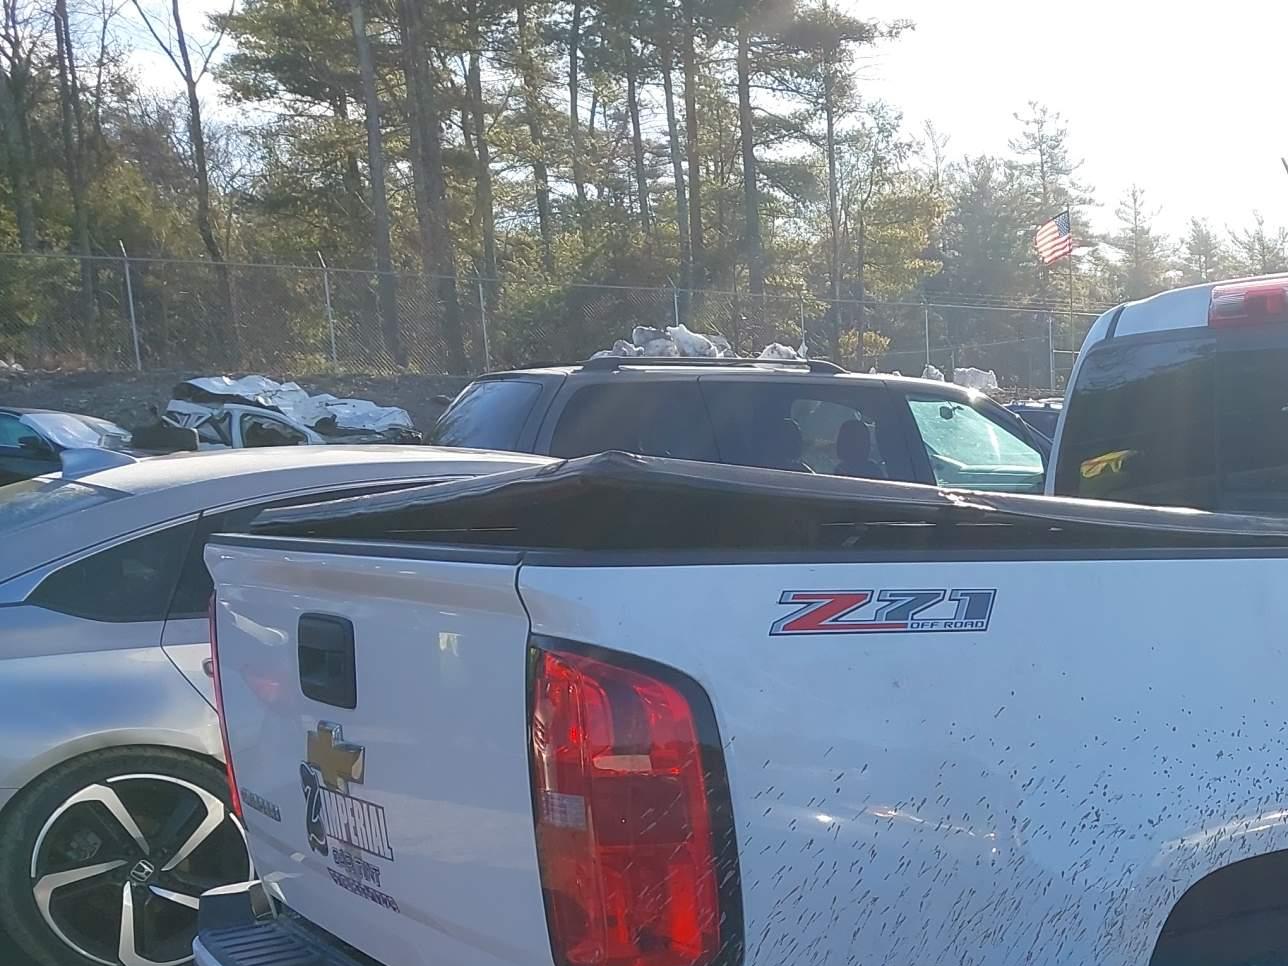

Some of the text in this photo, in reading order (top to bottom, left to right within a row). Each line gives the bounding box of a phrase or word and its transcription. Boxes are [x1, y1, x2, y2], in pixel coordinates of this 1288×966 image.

[769, 588, 998, 636] Z71
[909, 620, 985, 630] OFF ROAD
[319, 785, 394, 861] IMPERIAL
